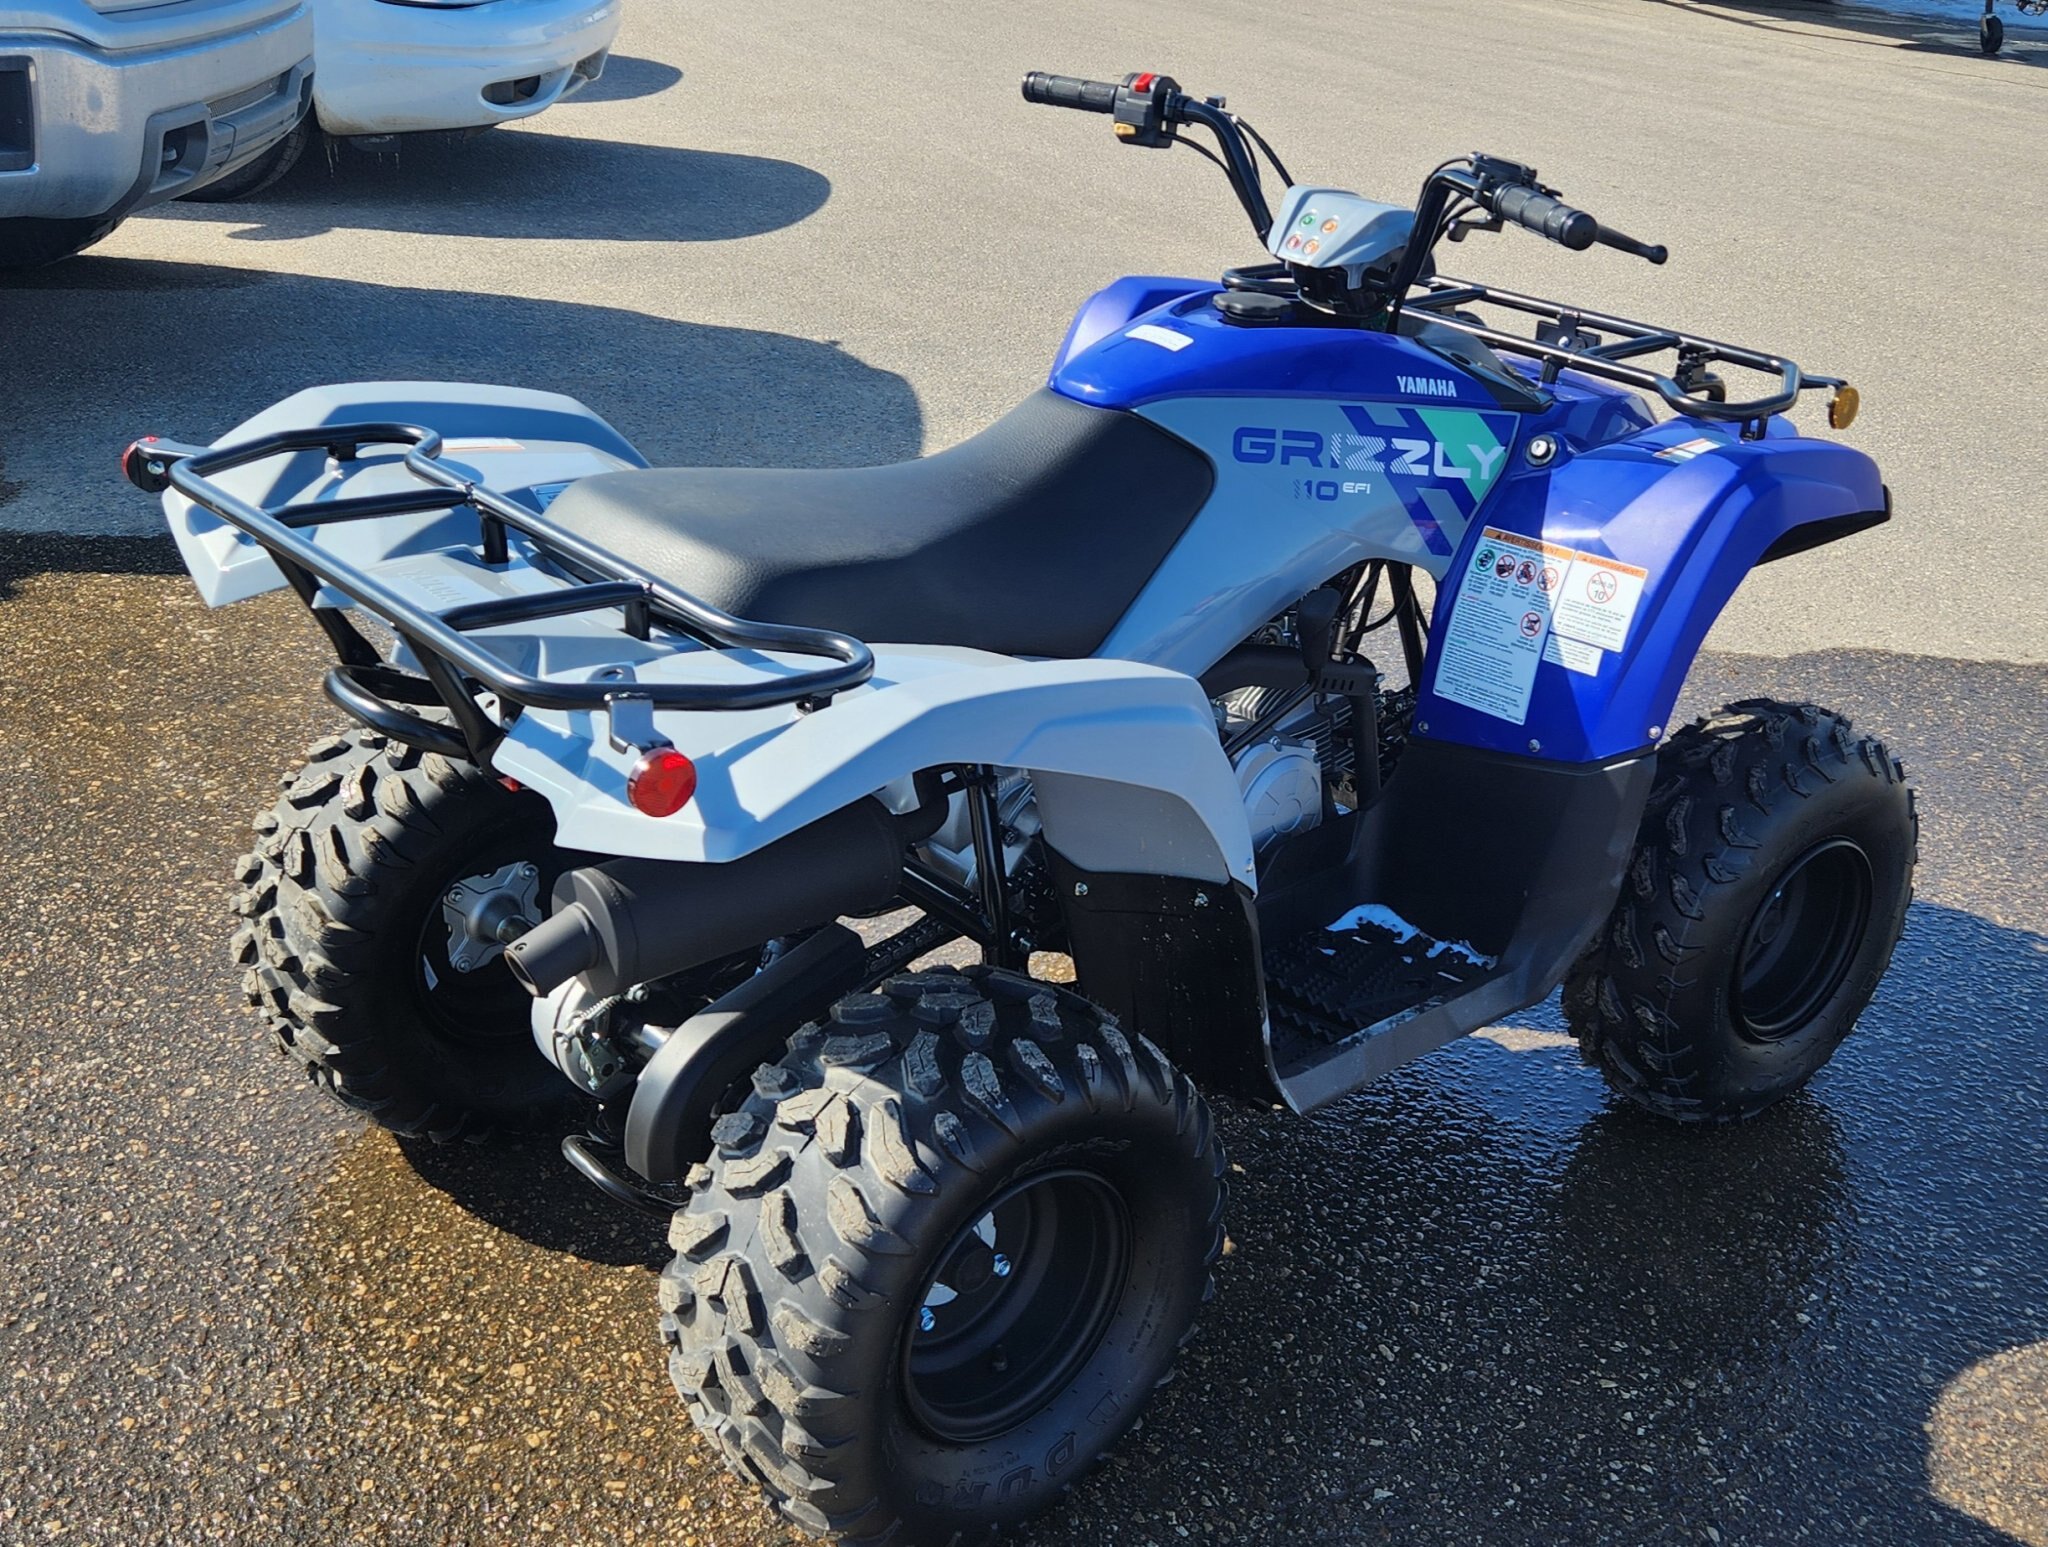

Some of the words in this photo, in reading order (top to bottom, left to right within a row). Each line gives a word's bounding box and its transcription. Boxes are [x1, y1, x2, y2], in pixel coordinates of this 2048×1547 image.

[1396, 375, 1457, 398] YAMAHA
[1233, 426, 1506, 480] GRIZZLY
[1342, 482, 1371, 495] EFI
[1593, 590, 1606, 601] 10
